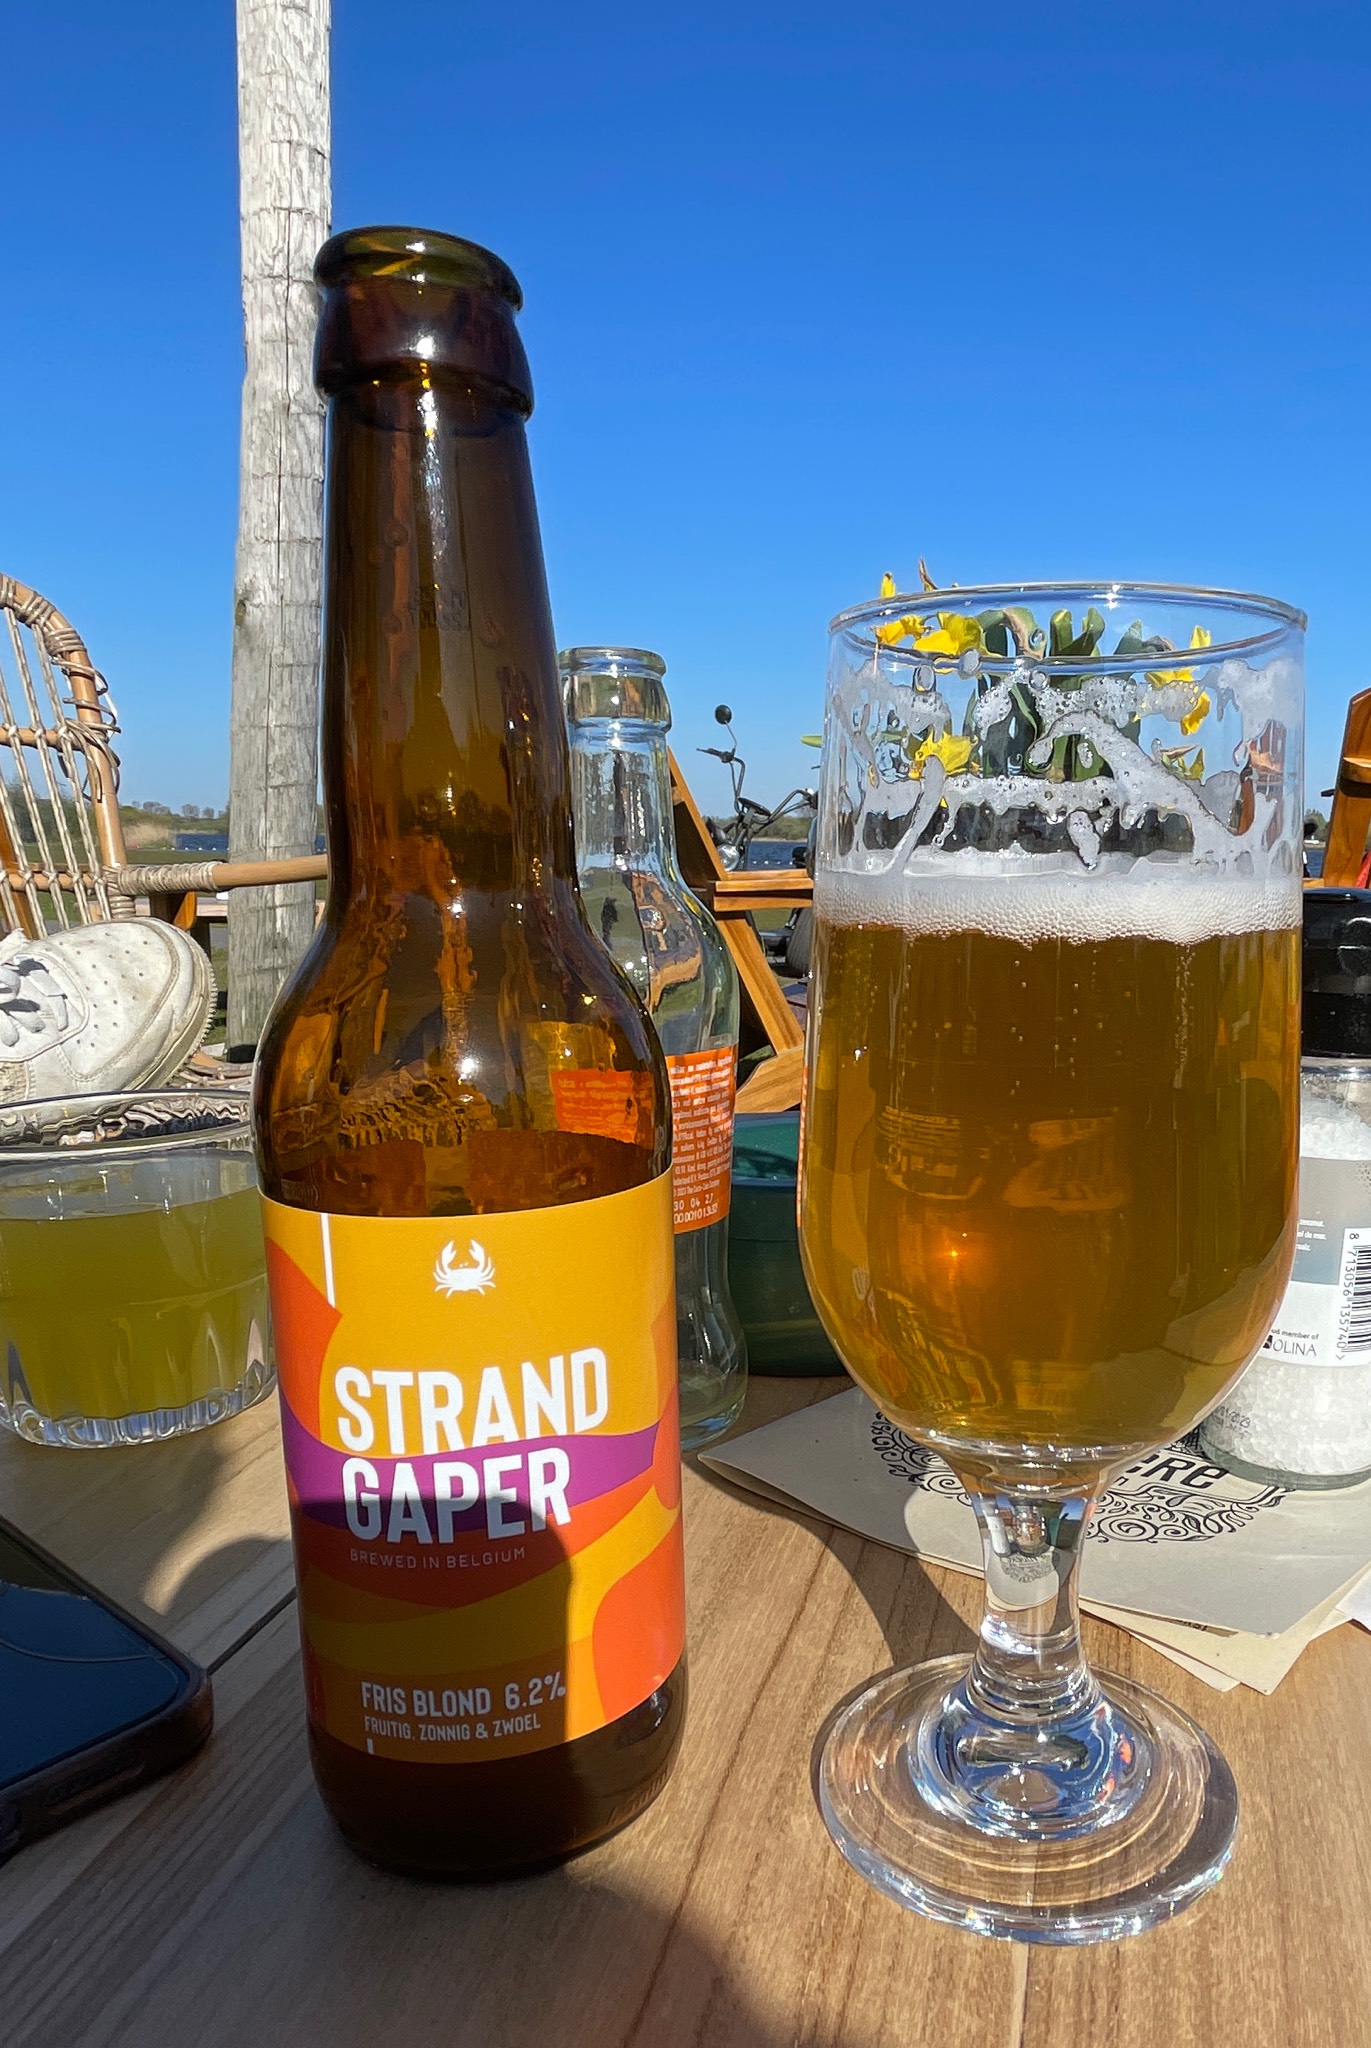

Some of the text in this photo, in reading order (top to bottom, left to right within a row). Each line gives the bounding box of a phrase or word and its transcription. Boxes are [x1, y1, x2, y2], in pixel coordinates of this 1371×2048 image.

[1349, 1232, 1360, 1240] 8
[1281, 1330, 1310, 1340] member
[1272, 1339, 1317, 1357] OLINA
[334, 1347, 609, 1455] STRAND
[341, 1447, 572, 1545] GAPER
[350, 1547, 526, 1569] BREWED IN BELGIUM
[361, 1671, 566, 1718] FRIS BLOND 6.2%
[418, 1724, 470, 1741] ZONNIG
[475, 1722, 488, 1739] &
[493, 1713, 542, 1737] ZWOEL
